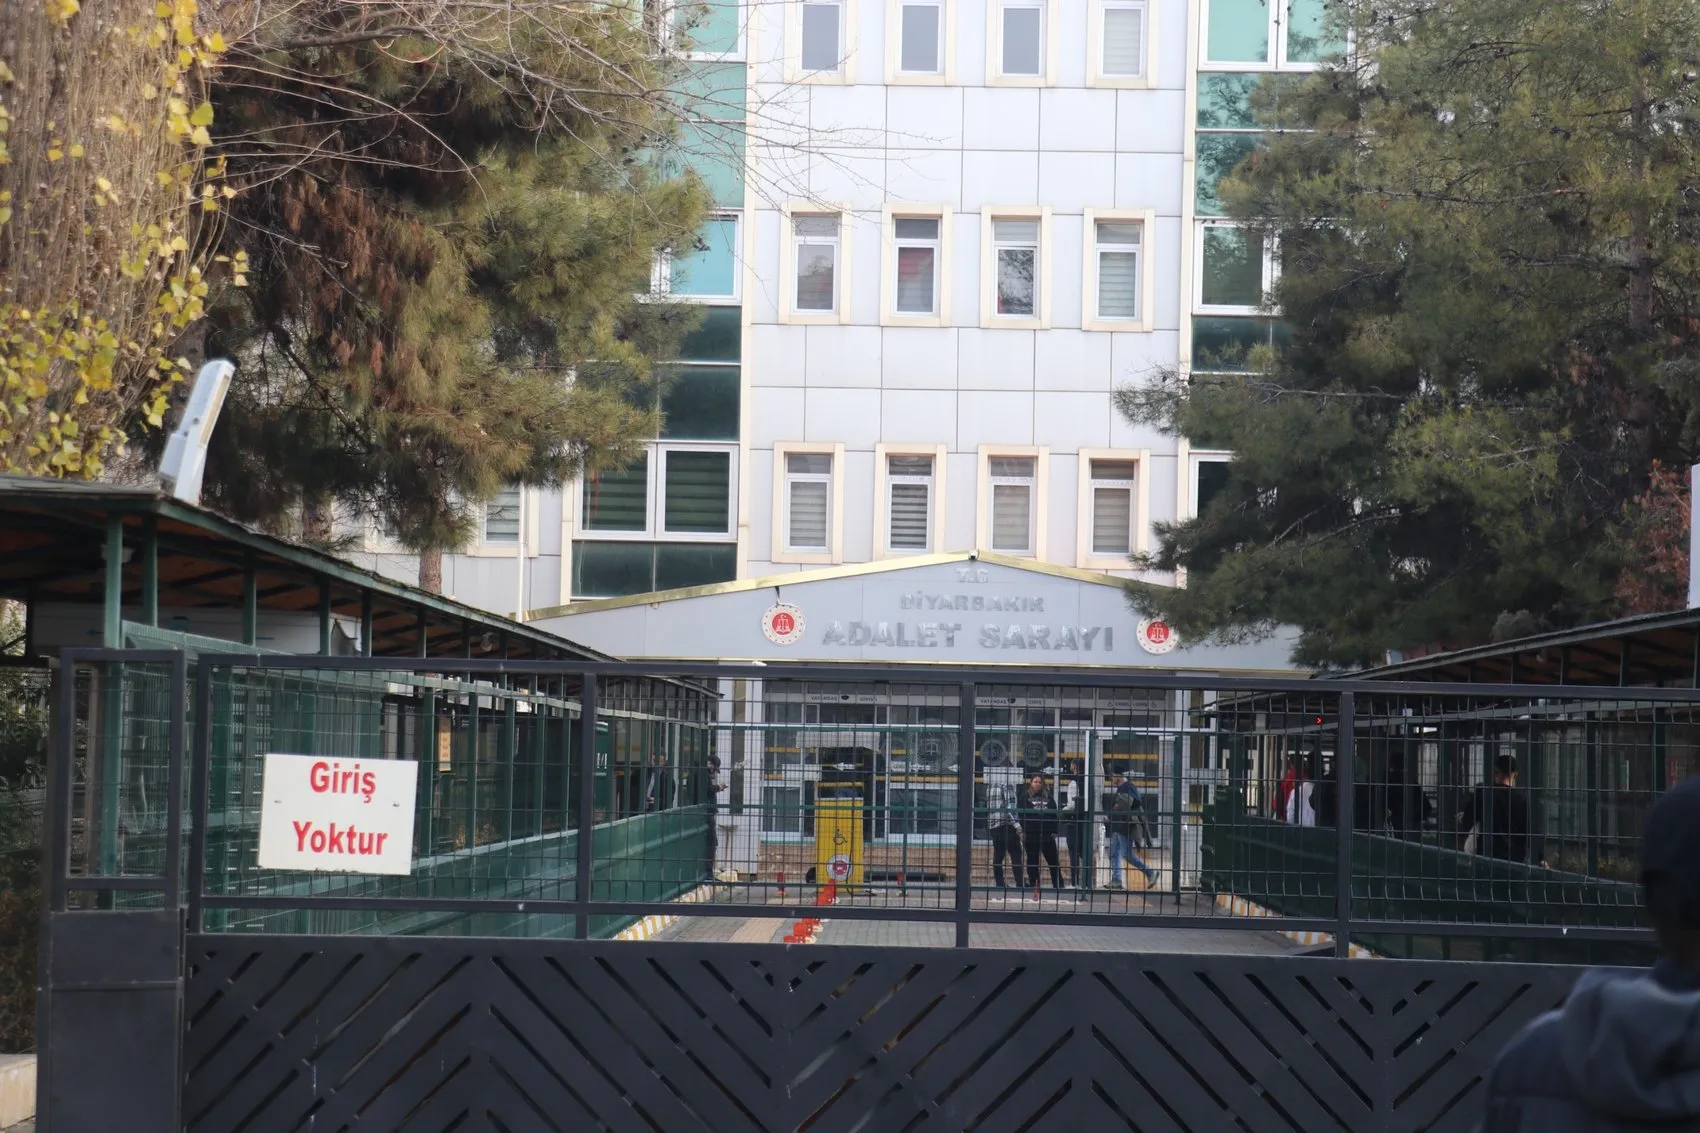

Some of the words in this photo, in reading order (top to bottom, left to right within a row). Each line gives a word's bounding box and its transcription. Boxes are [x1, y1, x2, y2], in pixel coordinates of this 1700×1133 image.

[900, 590, 1044, 612] DİYARBAKIR
[822, 620, 961, 648] ADALET
[979, 623, 1113, 652] SARAYI
[310, 761, 376, 803] Giriş
[292, 820, 388, 855] Yoktur
